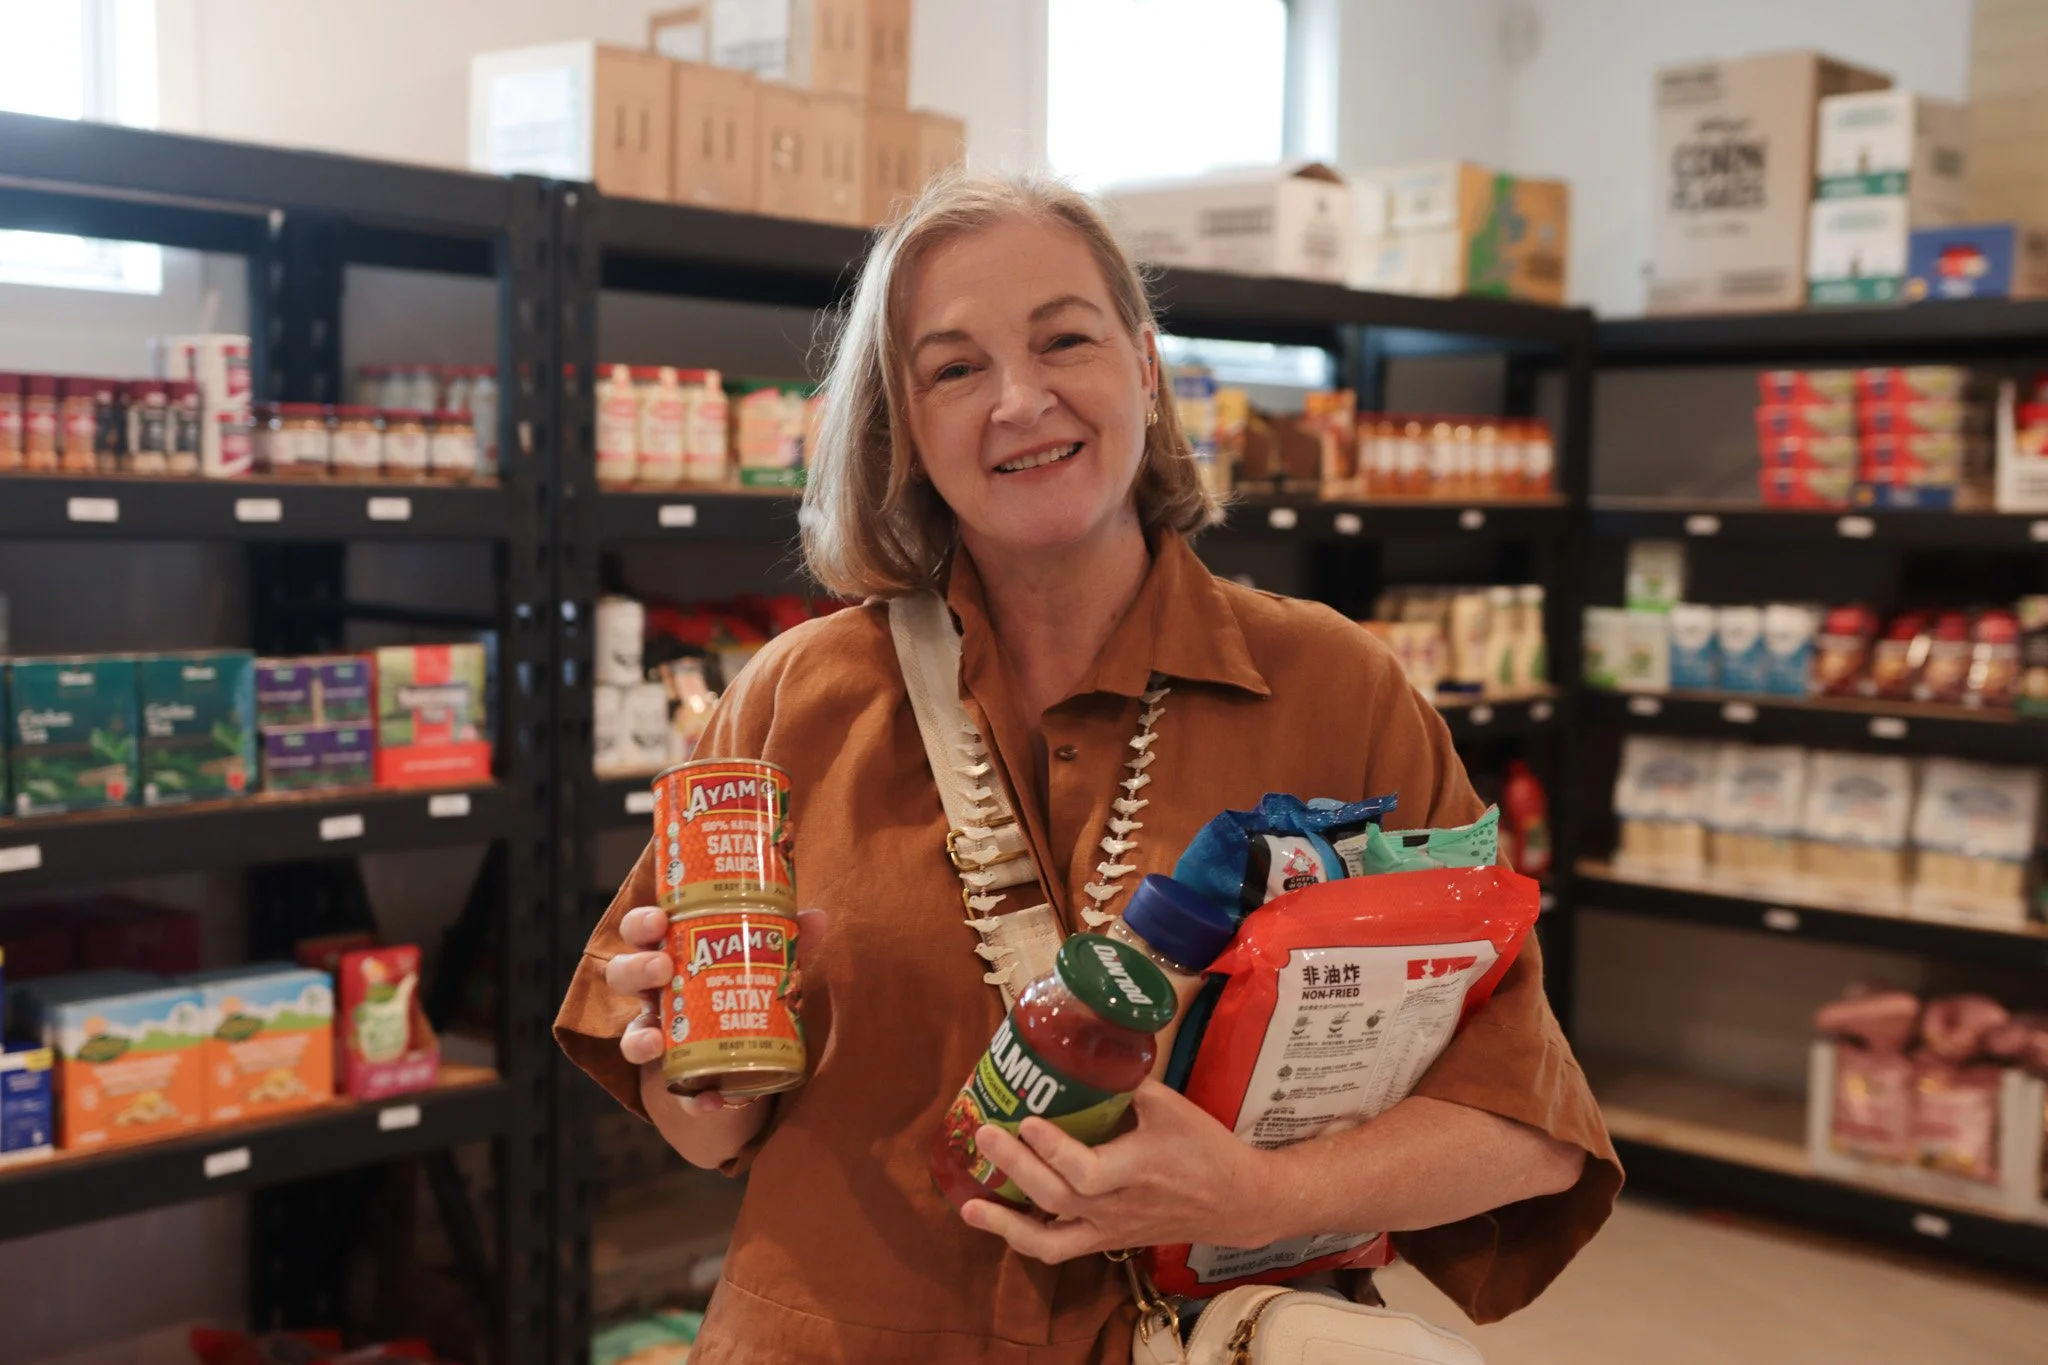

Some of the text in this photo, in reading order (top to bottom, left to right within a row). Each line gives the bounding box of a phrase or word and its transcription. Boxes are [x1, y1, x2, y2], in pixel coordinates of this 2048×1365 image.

[682, 779, 756, 822] AYAM
[707, 834, 766, 855] SATAY
[687, 930, 762, 976] AYAM
[1092, 944, 1154, 1005] DOLMIO
[1302, 963, 1361, 986] 非油炸
[711, 989, 773, 1012] SATAY
[1301, 988, 1360, 1000] NON-FRIED
[719, 1013, 769, 1031] SAUCE
[718, 1039, 773, 1051] READY TO USE
[990, 1019, 1059, 1115] OLMIO
